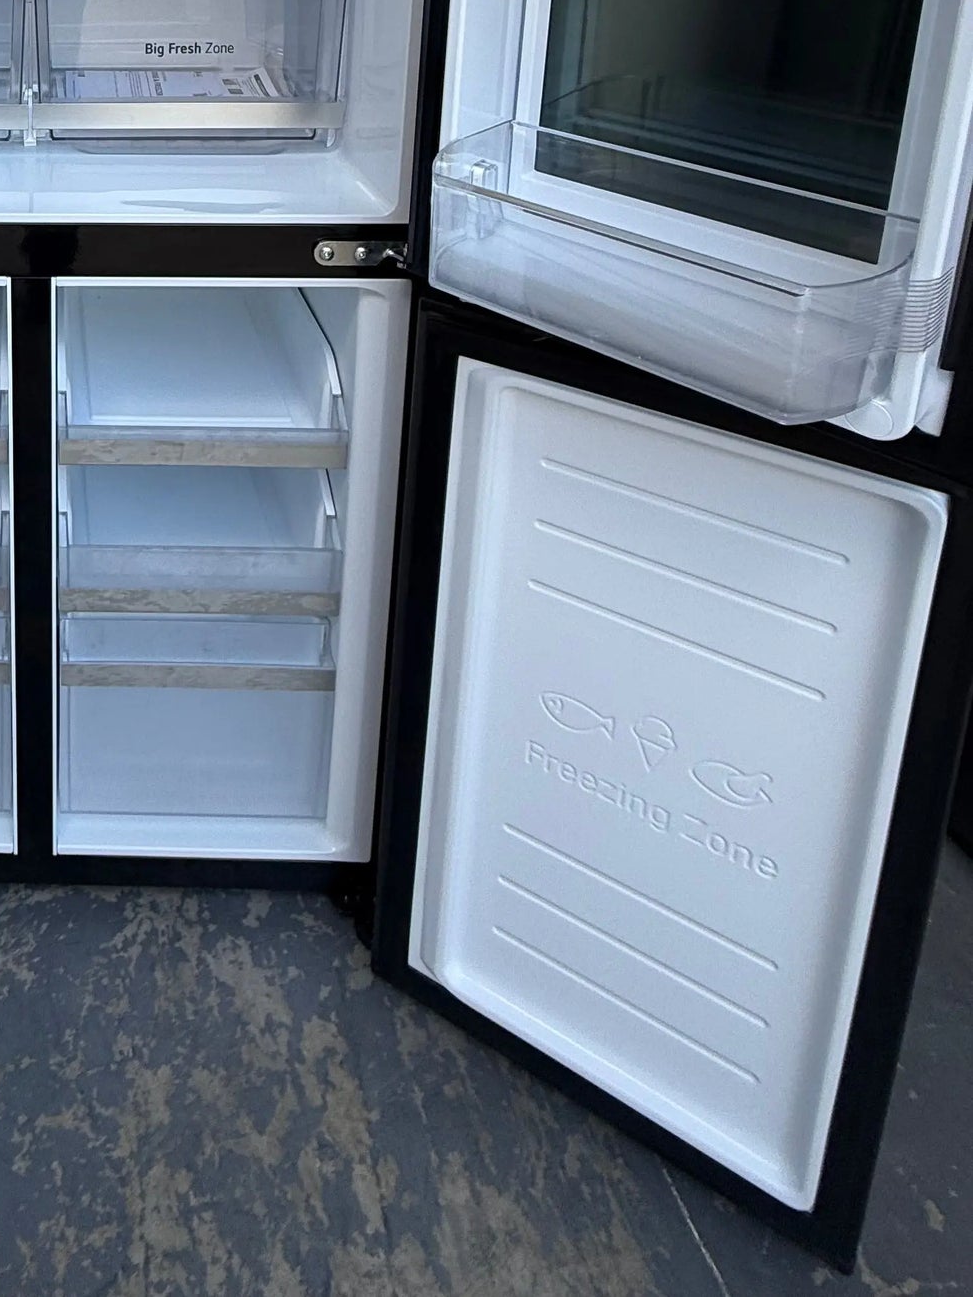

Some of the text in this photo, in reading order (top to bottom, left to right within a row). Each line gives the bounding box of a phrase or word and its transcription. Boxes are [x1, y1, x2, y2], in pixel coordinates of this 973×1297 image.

[145, 42, 234, 58] Big Fresh Zone
[524, 738, 780, 880] Freezing Zone
